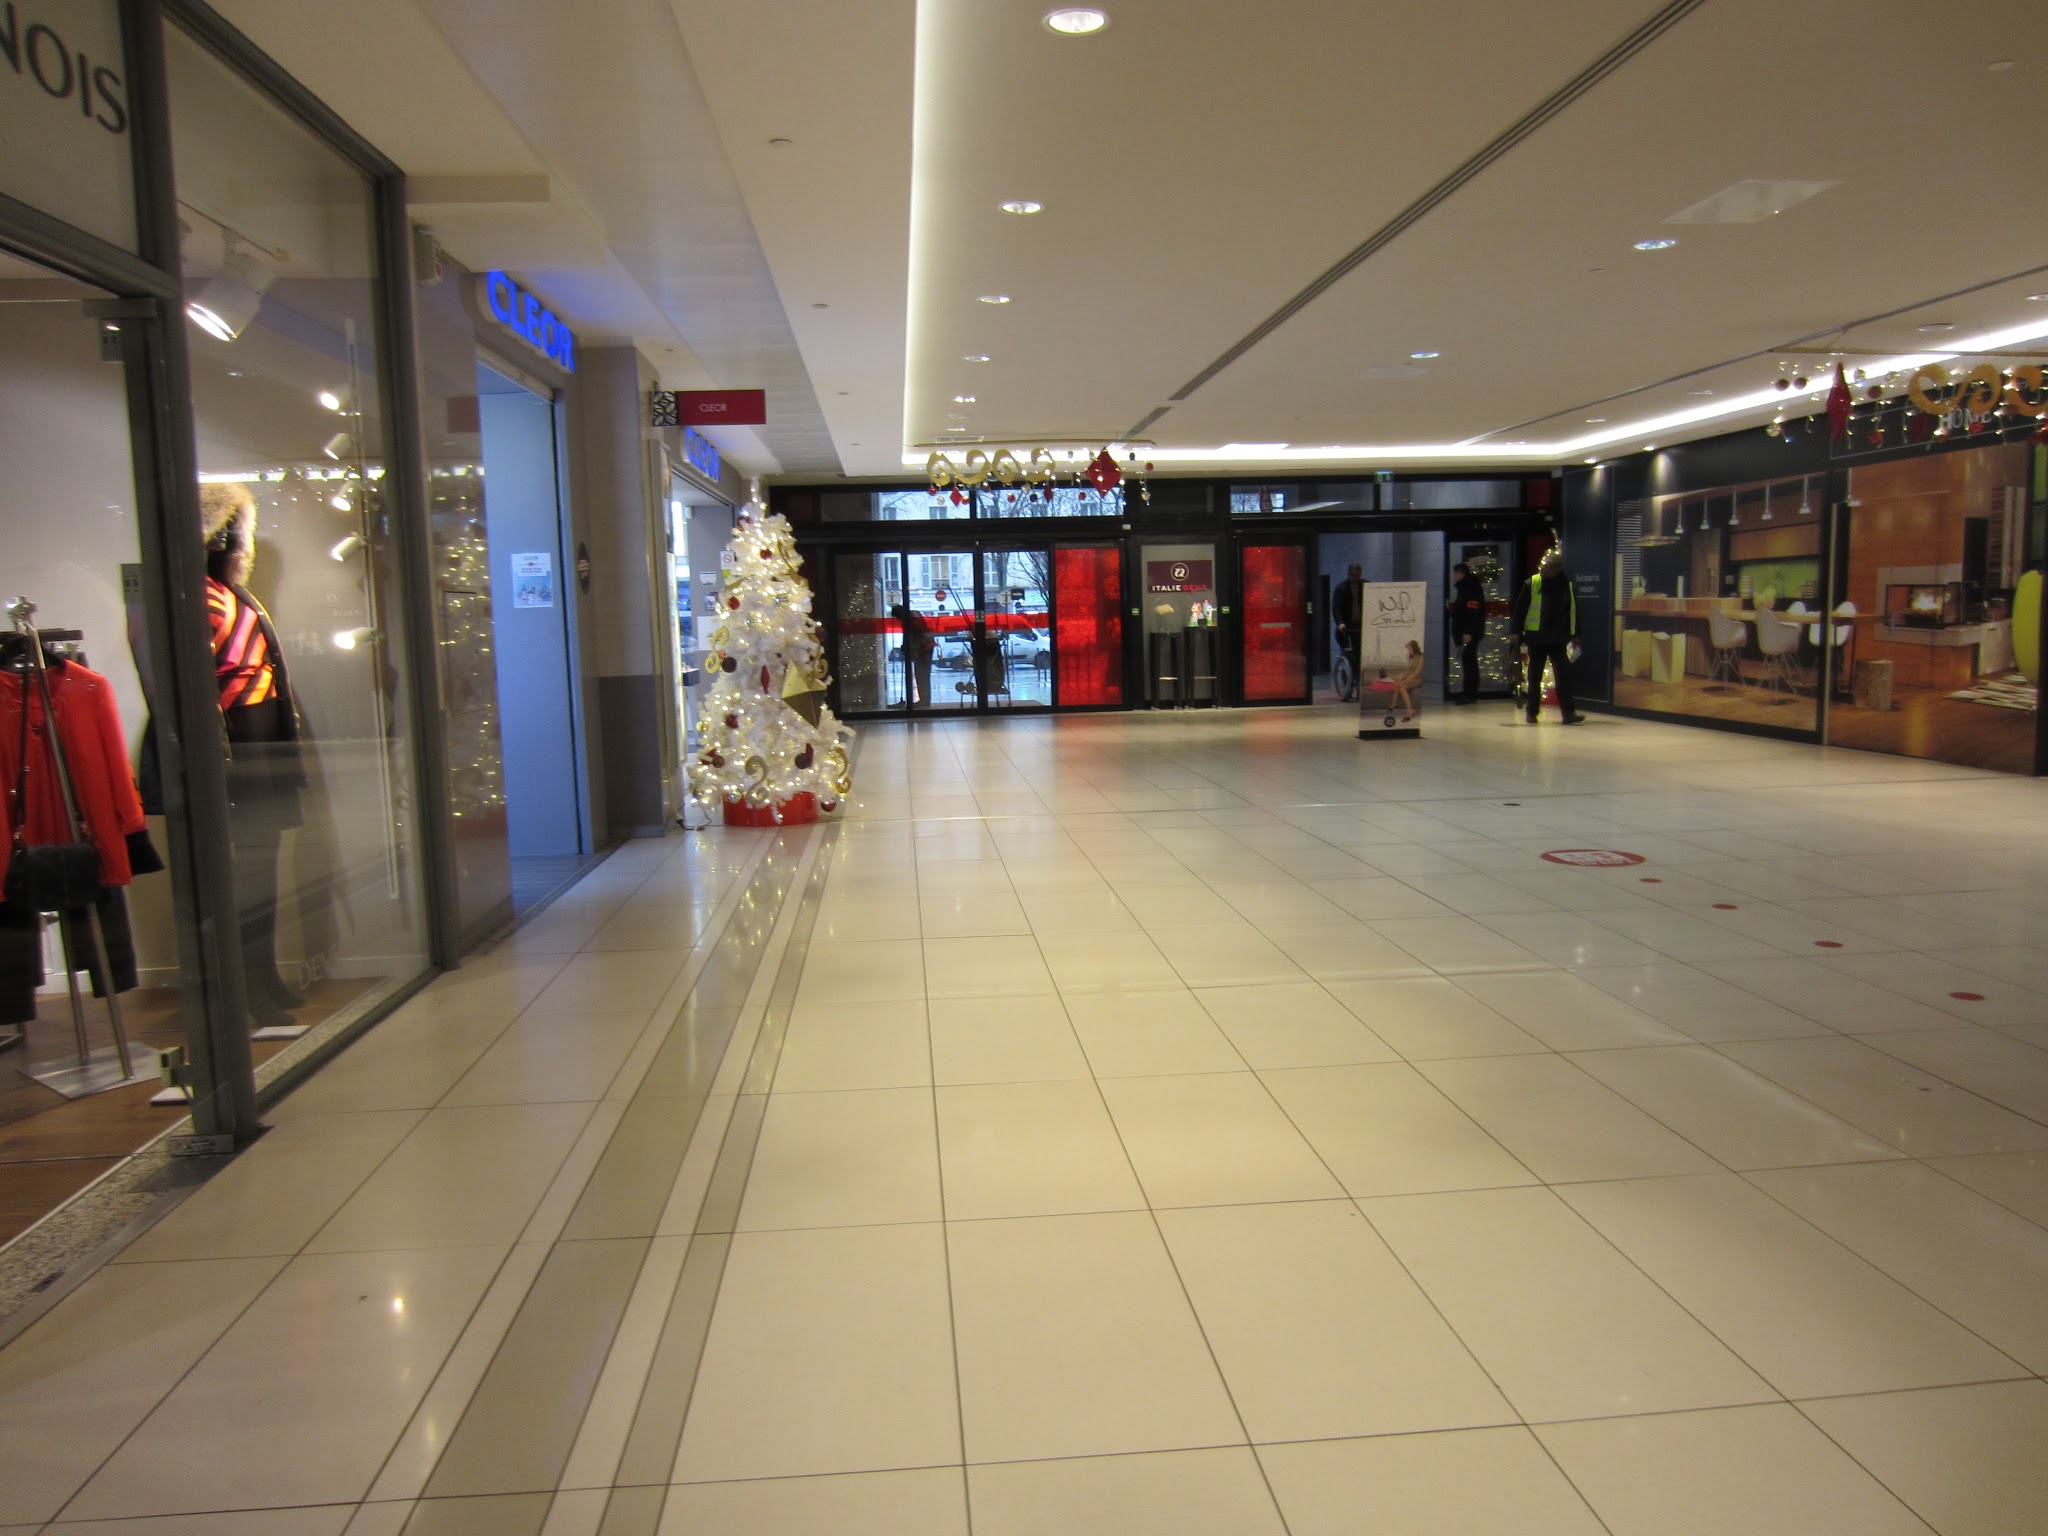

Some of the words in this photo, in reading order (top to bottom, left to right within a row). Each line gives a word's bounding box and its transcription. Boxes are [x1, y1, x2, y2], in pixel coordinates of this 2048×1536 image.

[486, 269, 576, 373] CLEOR
[700, 403, 728, 412] CLEOR
[1152, 584, 1182, 592] ITALIE
